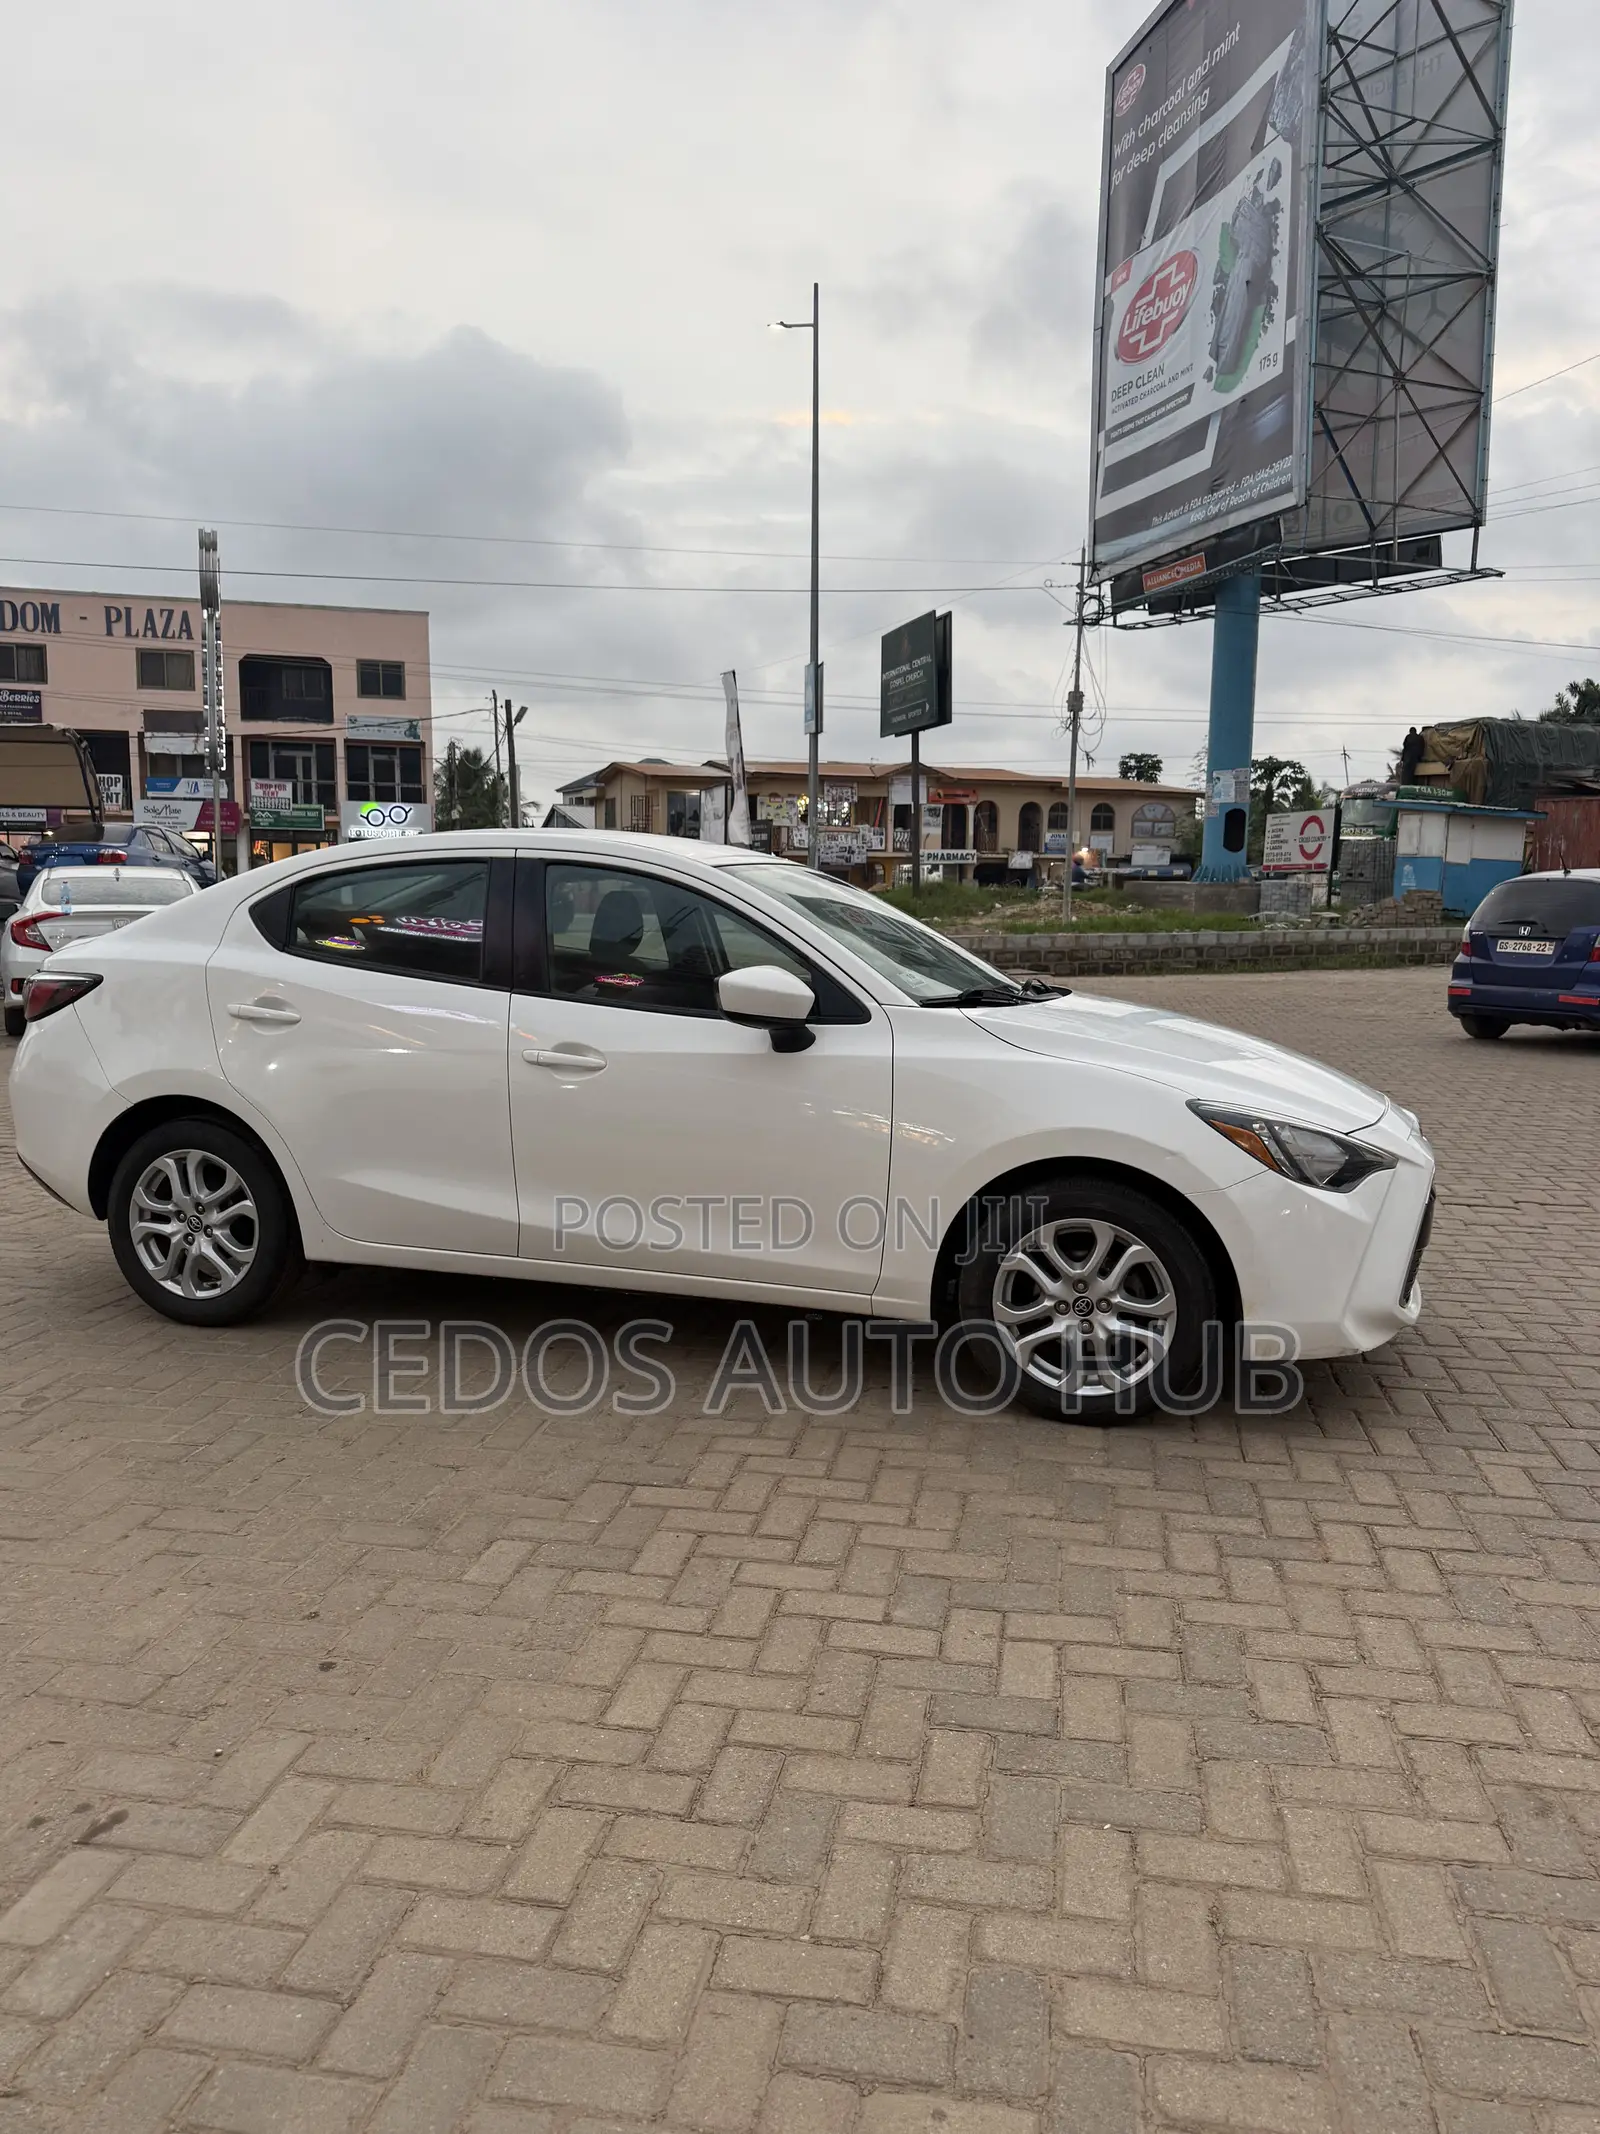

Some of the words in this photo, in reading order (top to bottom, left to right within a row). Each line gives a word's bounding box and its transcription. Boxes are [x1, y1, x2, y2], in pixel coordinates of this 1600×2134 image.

[1138, 77, 1186, 138] charcoal
[1187, 51, 1210, 91] and
[1212, 21, 1240, 66] mint
[1110, 166, 1127, 195] for
[1126, 141, 1156, 174] deep
[1158, 87, 1210, 148] cleansing
[1122, 278, 1192, 338] Lifebuoy
[1259, 356, 1272, 372] 175
[1272, 353, 1278, 367] g
[1111, 380, 1134, 402] DEEP
[1135, 363, 1165, 390] CLEAN
[1111, 395, 1139, 414] ACTIVATED
[1140, 382, 1167, 404] CHARCOAL
[1168, 372, 1180, 387] AND
[1180, 363, 1194, 380] MINT
[1151, 516, 1164, 528] This
[1163, 508, 1184, 522] Advert
[1190, 498, 1202, 510] FDA
[1202, 480, 1236, 506] approved
[1189, 511, 1206, 524] Keep
[1207, 504, 1220, 517] Out
[1220, 498, 1230, 512] of
[1229, 492, 1250, 508] Reach
[1252, 484, 1261, 498] of
[1260, 472, 1292, 494] Children
[1146, 569, 1174, 586] ALLIANCE
[1181, 561, 1202, 574] MEDIA
[0, 600, 62, 634] DOM
[104, 606, 194, 640] PLAZA
[889, 676, 905, 690] GOSPEL
[905, 669, 924, 683] CHURCH
[912, 653, 932, 669] CENTRAL
[255, 782, 274, 790] SHOP
[274, 784, 287, 792] FOR
[927, 852, 976, 861] PHARMACY
